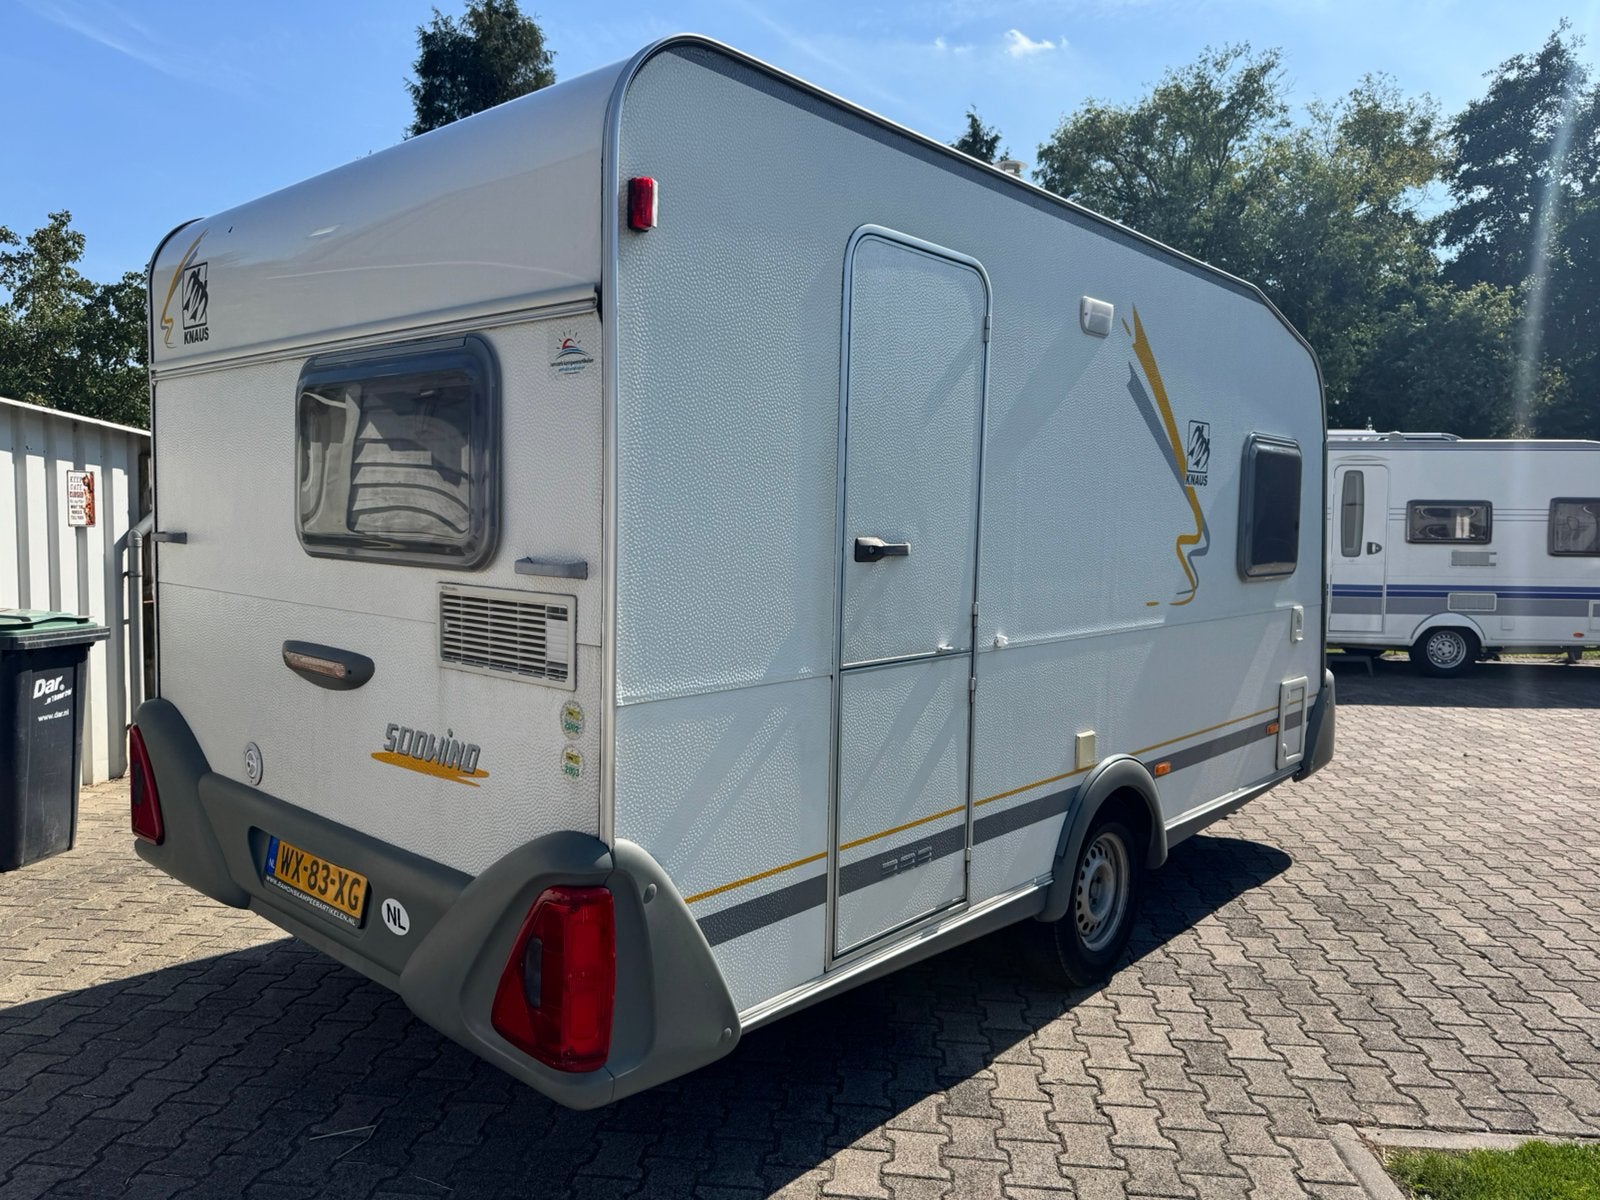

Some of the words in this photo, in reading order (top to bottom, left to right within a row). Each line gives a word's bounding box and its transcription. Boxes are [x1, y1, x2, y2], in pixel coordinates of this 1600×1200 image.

[184, 327, 209, 345] KNAUS
[1185, 474, 1208, 486] KNAUS
[38, 709, 70, 722] www.dar.nl
[268, 859, 275, 869] NL
[280, 845, 361, 911] WX-83-XG
[266, 875, 356, 926] WWW.RAMONSKAMPEERARTIKELEN.NL
[386, 903, 406, 931] NL
